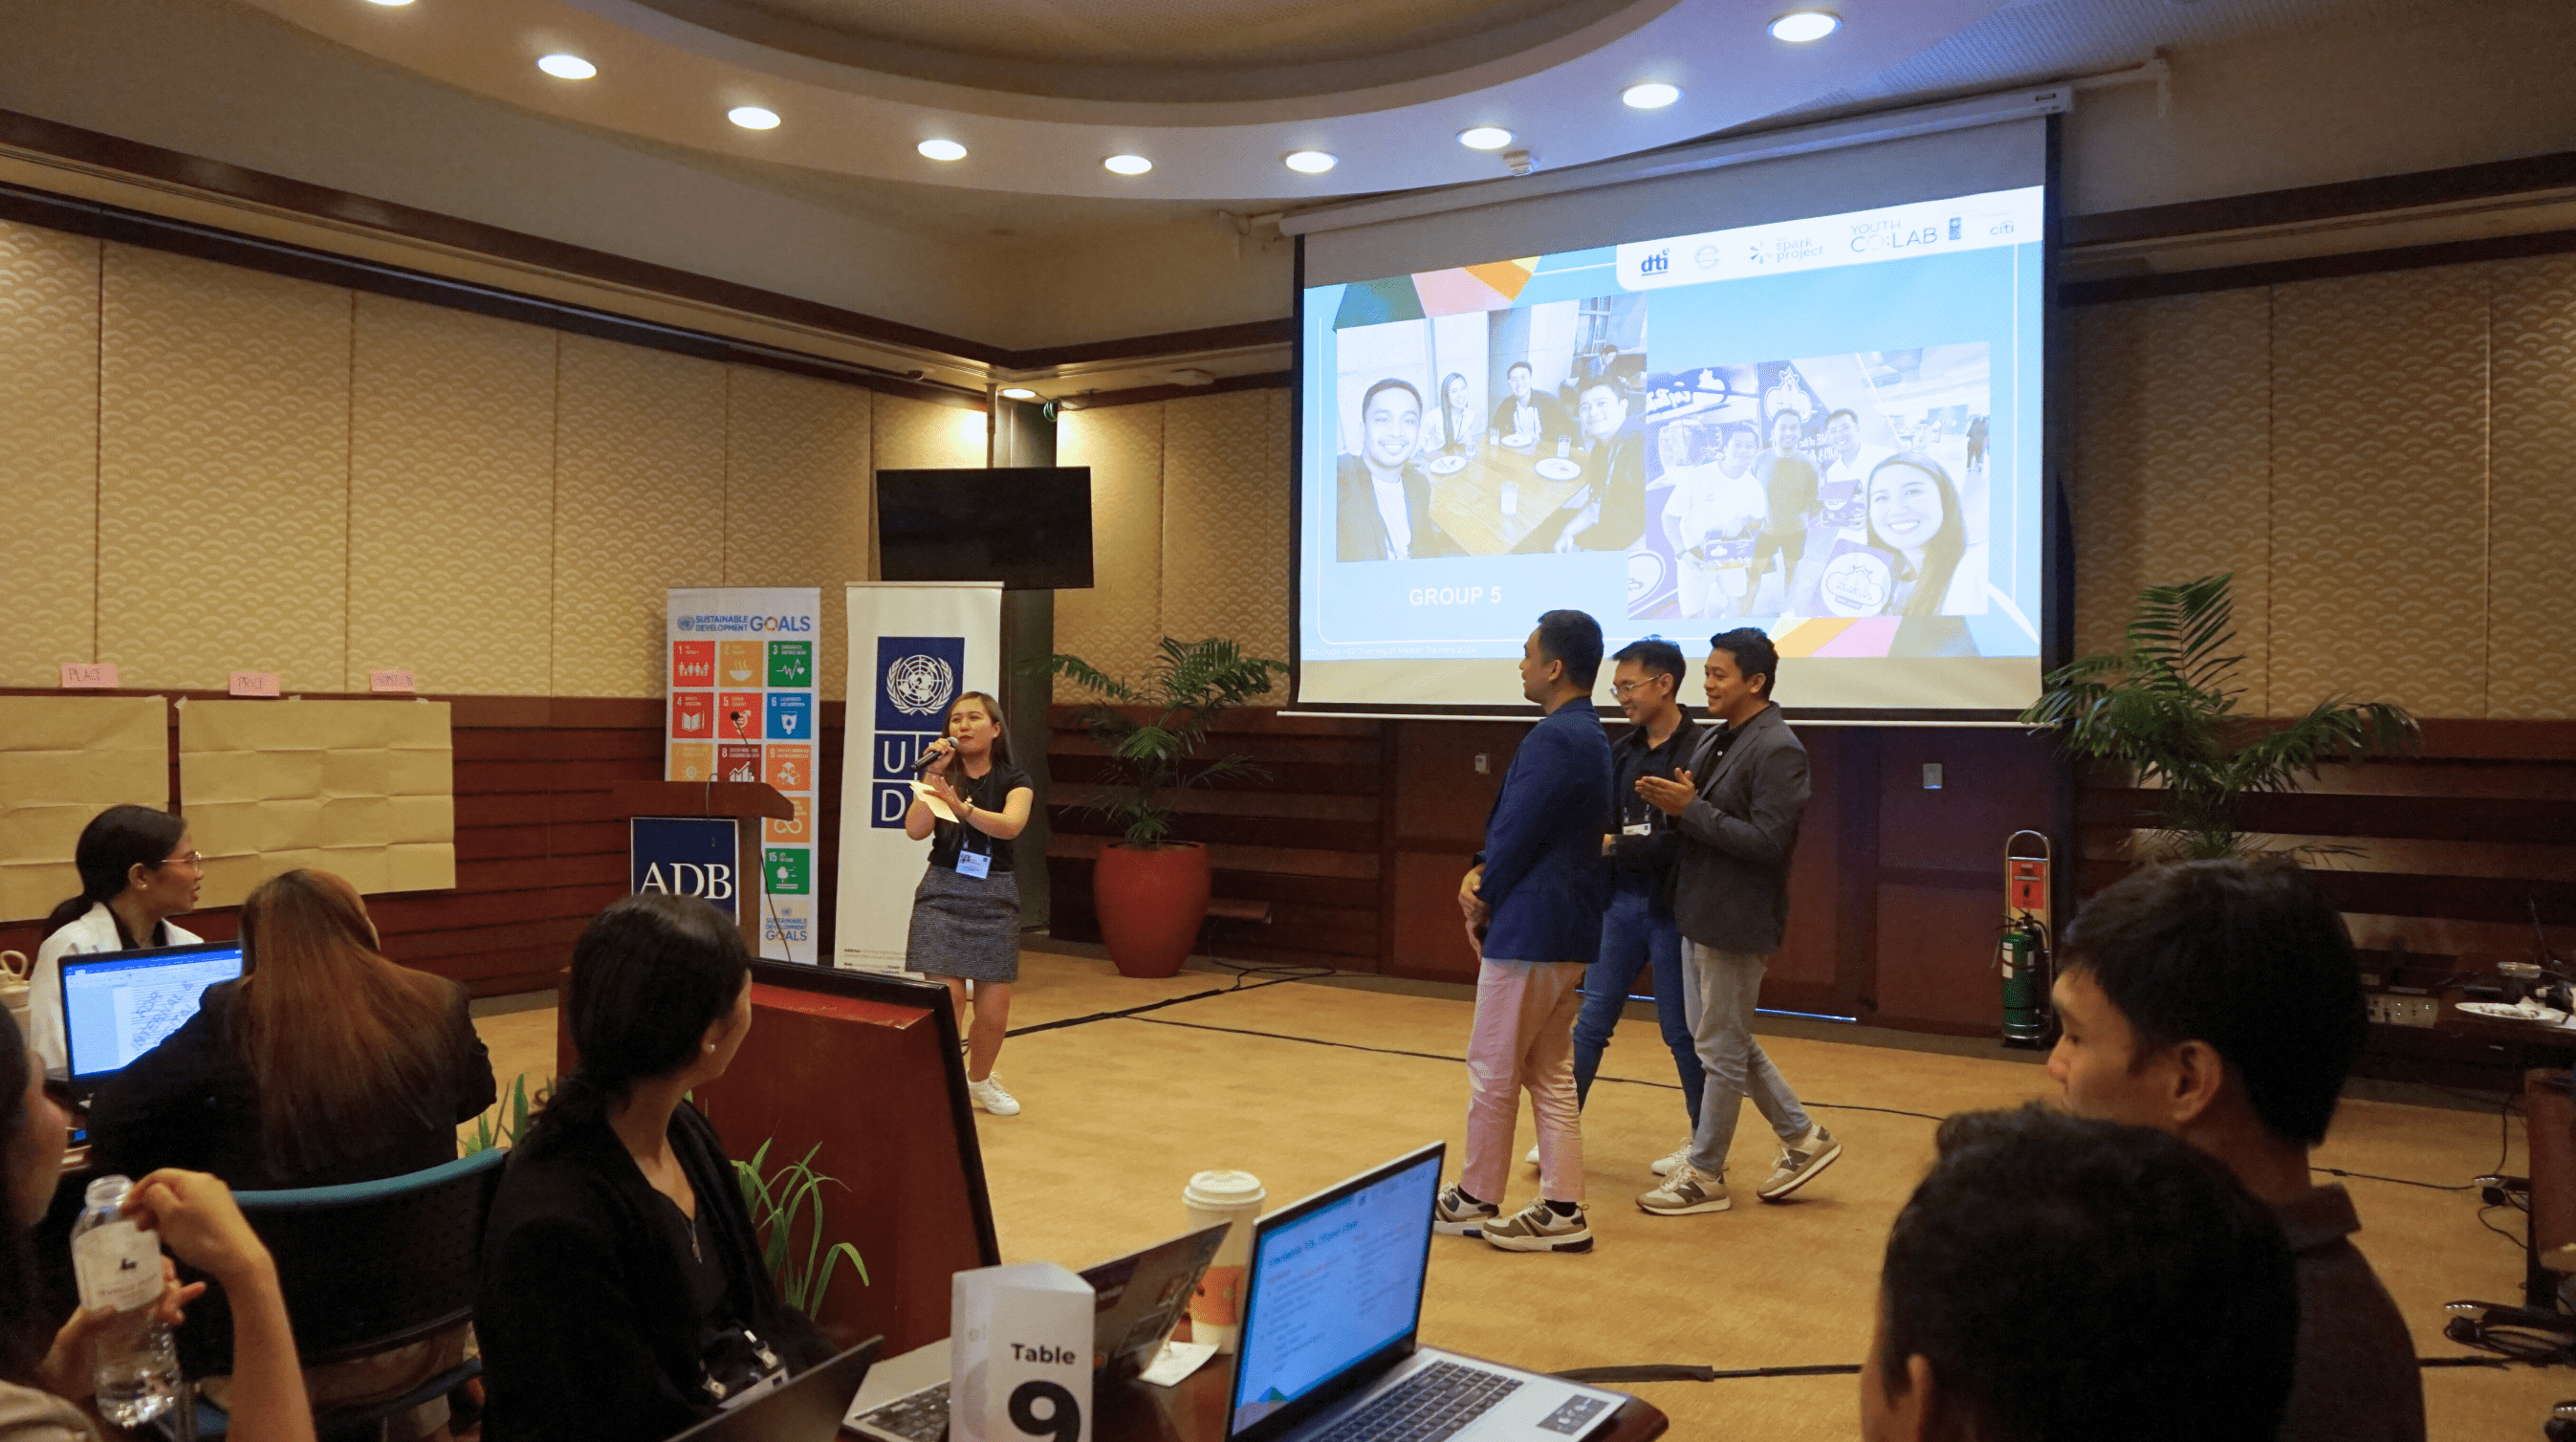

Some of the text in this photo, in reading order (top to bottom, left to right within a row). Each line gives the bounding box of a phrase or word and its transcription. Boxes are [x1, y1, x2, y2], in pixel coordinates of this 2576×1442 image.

[1851, 219, 1901, 234] YOUTH
[1990, 220, 2014, 235] citi
[1776, 237, 1813, 251] spark
[1641, 248, 1670, 273] dti
[1777, 246, 1823, 263] project
[1408, 585, 1502, 605] GROUP 5
[695, 615, 749, 623] SUSTAINABLE
[749, 615, 811, 632] GOALS
[695, 623, 748, 632] DEVELOPMENT
[773, 645, 778, 655] 3
[1426, 645, 1455, 654] Trainers
[723, 696, 729, 707] 5
[771, 696, 777, 707] 6
[722, 748, 728, 758] 8
[769, 852, 777, 863] 15
[640, 862, 732, 900] ADB
[765, 929, 807, 941] GOALS
[1011, 1343, 1077, 1366] Table
[1008, 1380, 1082, 1442] 9
